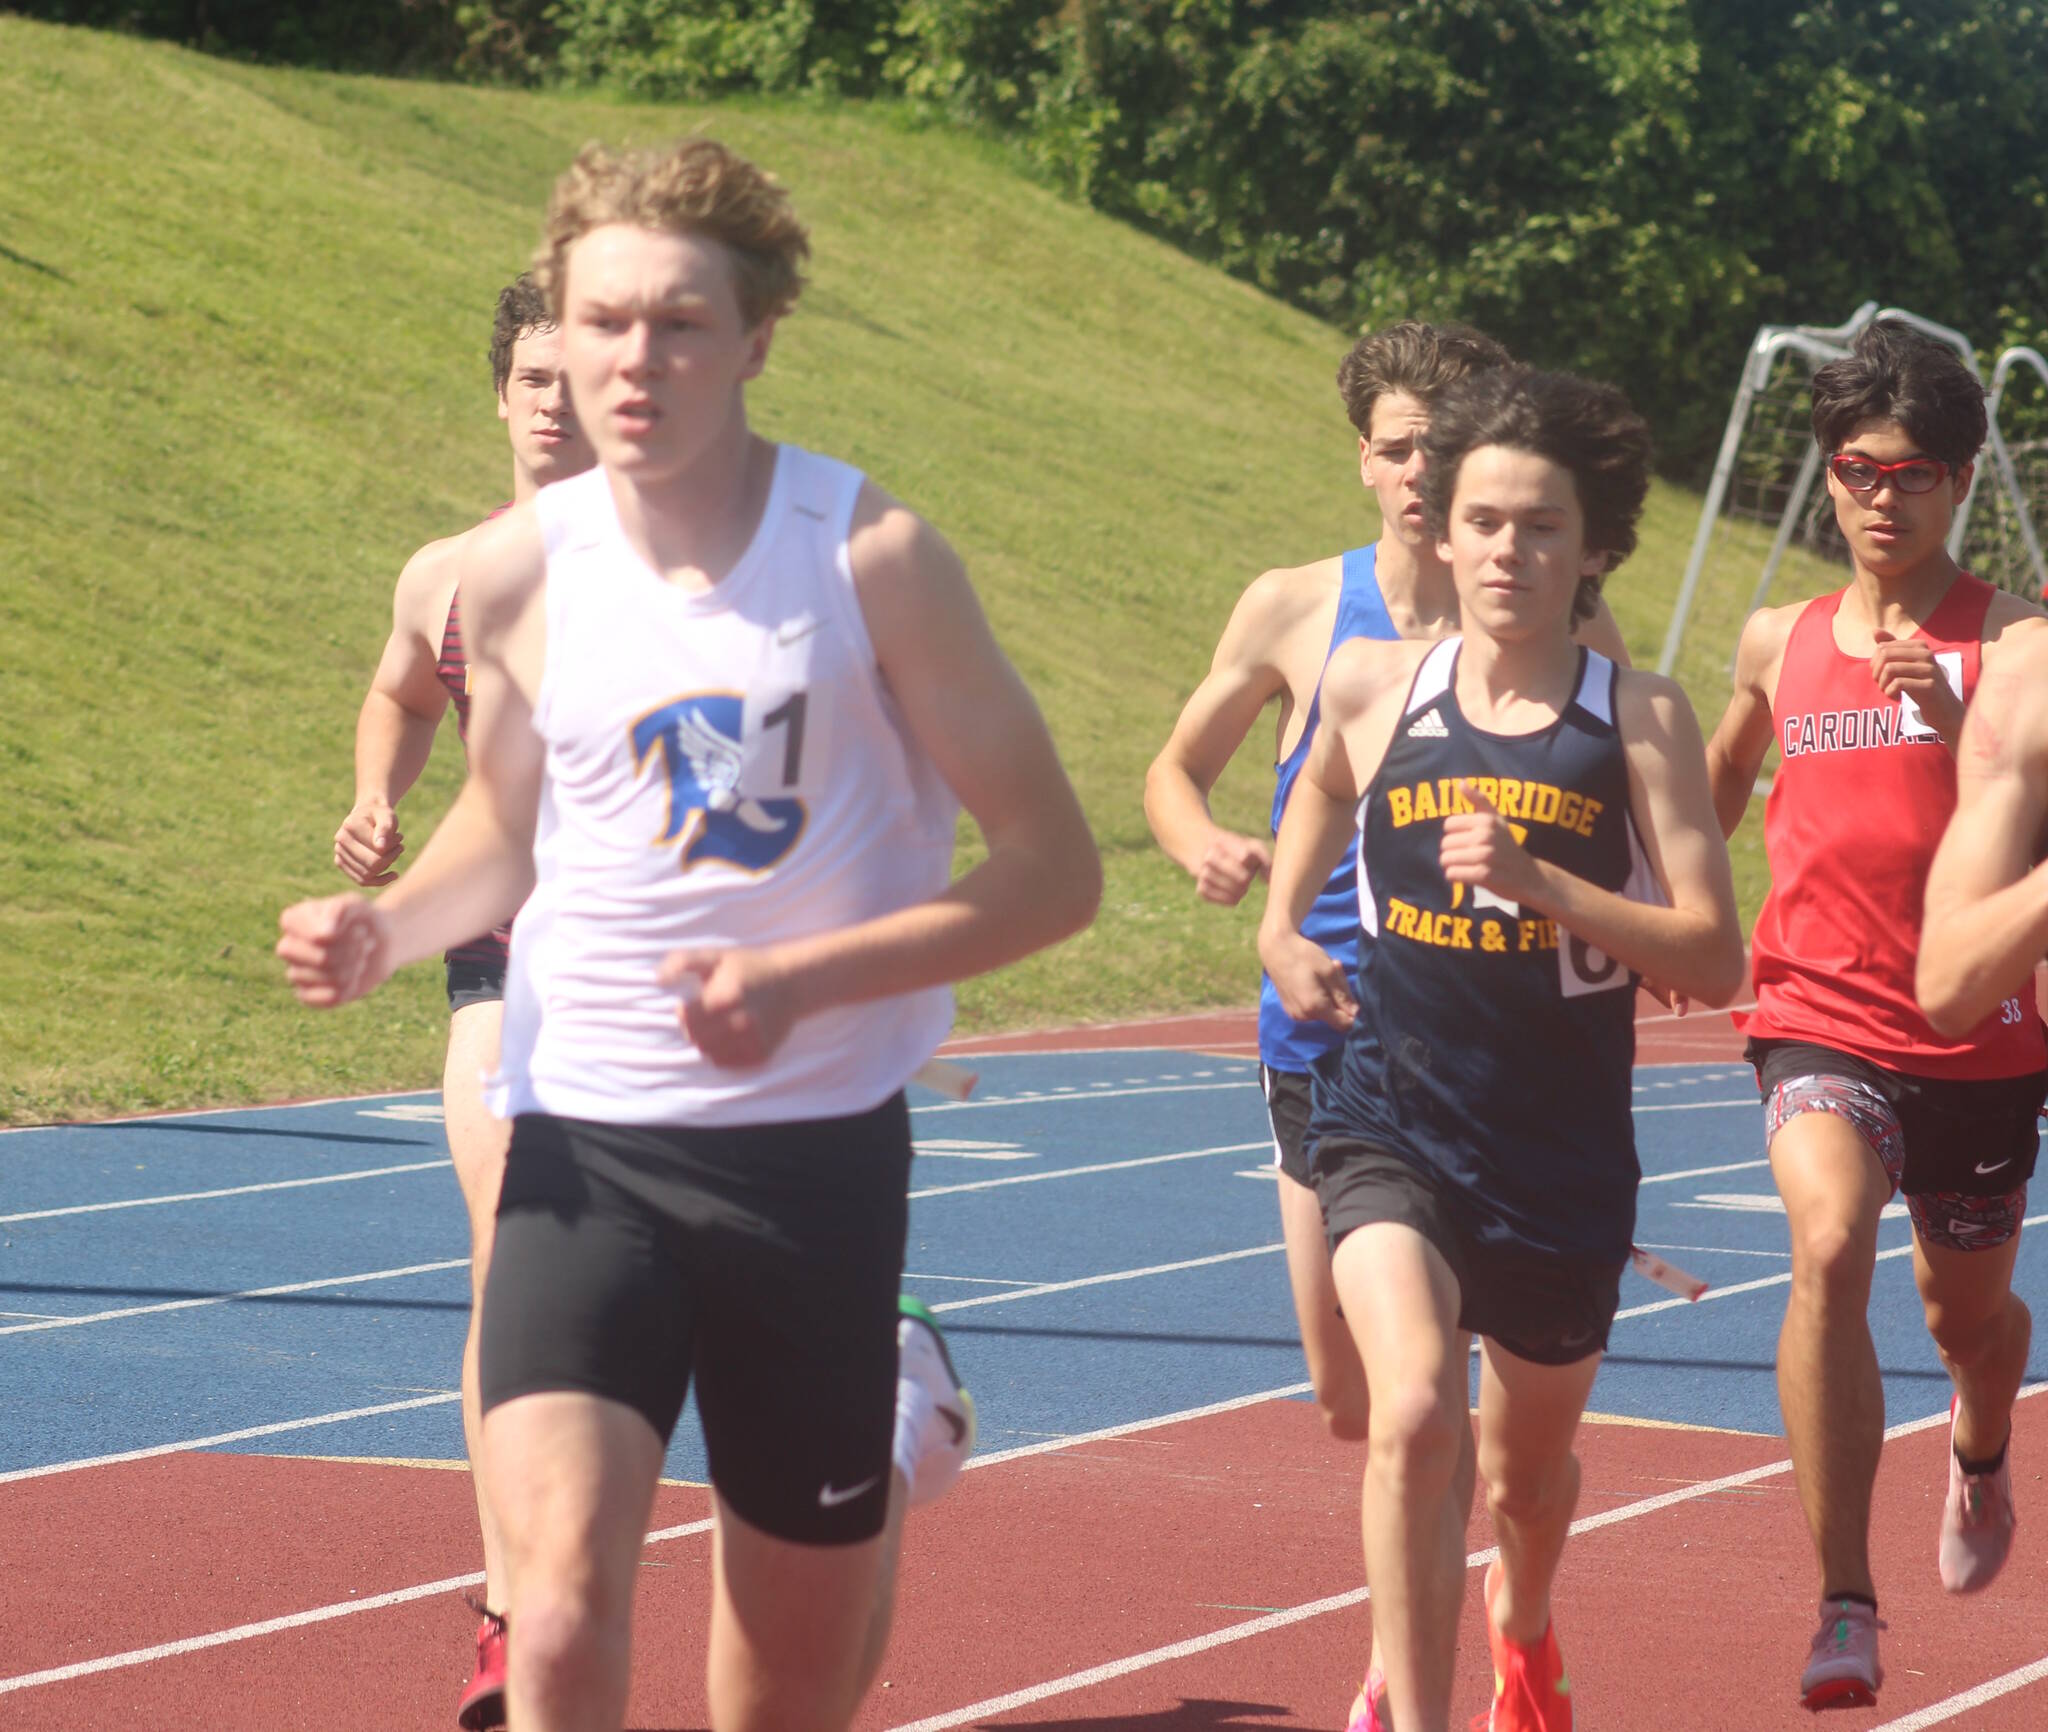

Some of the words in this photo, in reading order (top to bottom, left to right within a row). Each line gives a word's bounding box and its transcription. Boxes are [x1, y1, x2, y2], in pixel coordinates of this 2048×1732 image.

[762, 692, 808, 788] 1
[1387, 777, 1604, 837] BAINBRIDGE
[1384, 897, 1473, 949] TRACK
[1480, 919, 1507, 952] &
[1518, 918, 1560, 952] FIE
[2000, 997, 2022, 1024] 38
